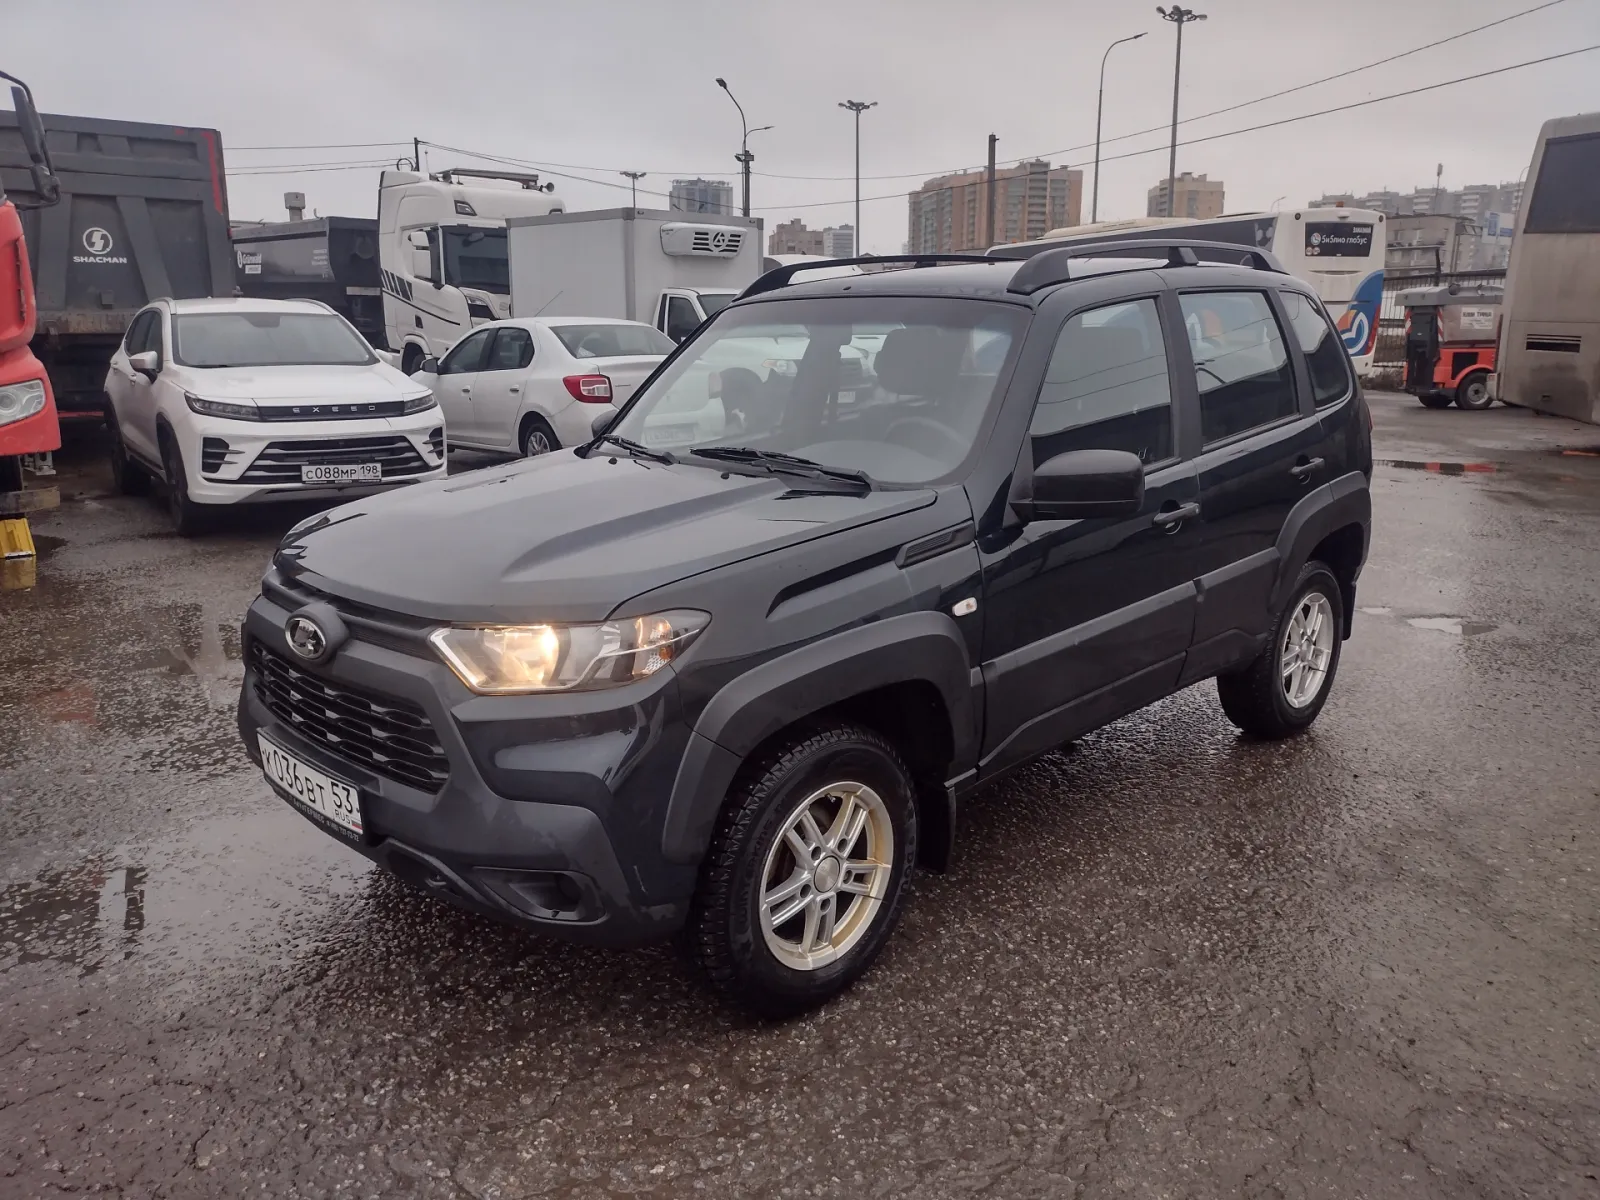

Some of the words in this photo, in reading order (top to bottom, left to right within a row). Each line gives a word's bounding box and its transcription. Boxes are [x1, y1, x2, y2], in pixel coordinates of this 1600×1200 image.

[73, 256, 128, 264] SHACMAN
[292, 405, 376, 413] EXEED
[361, 465, 378, 475] 198
[331, 781, 353, 814] 53
[334, 808, 351, 825] RUS
